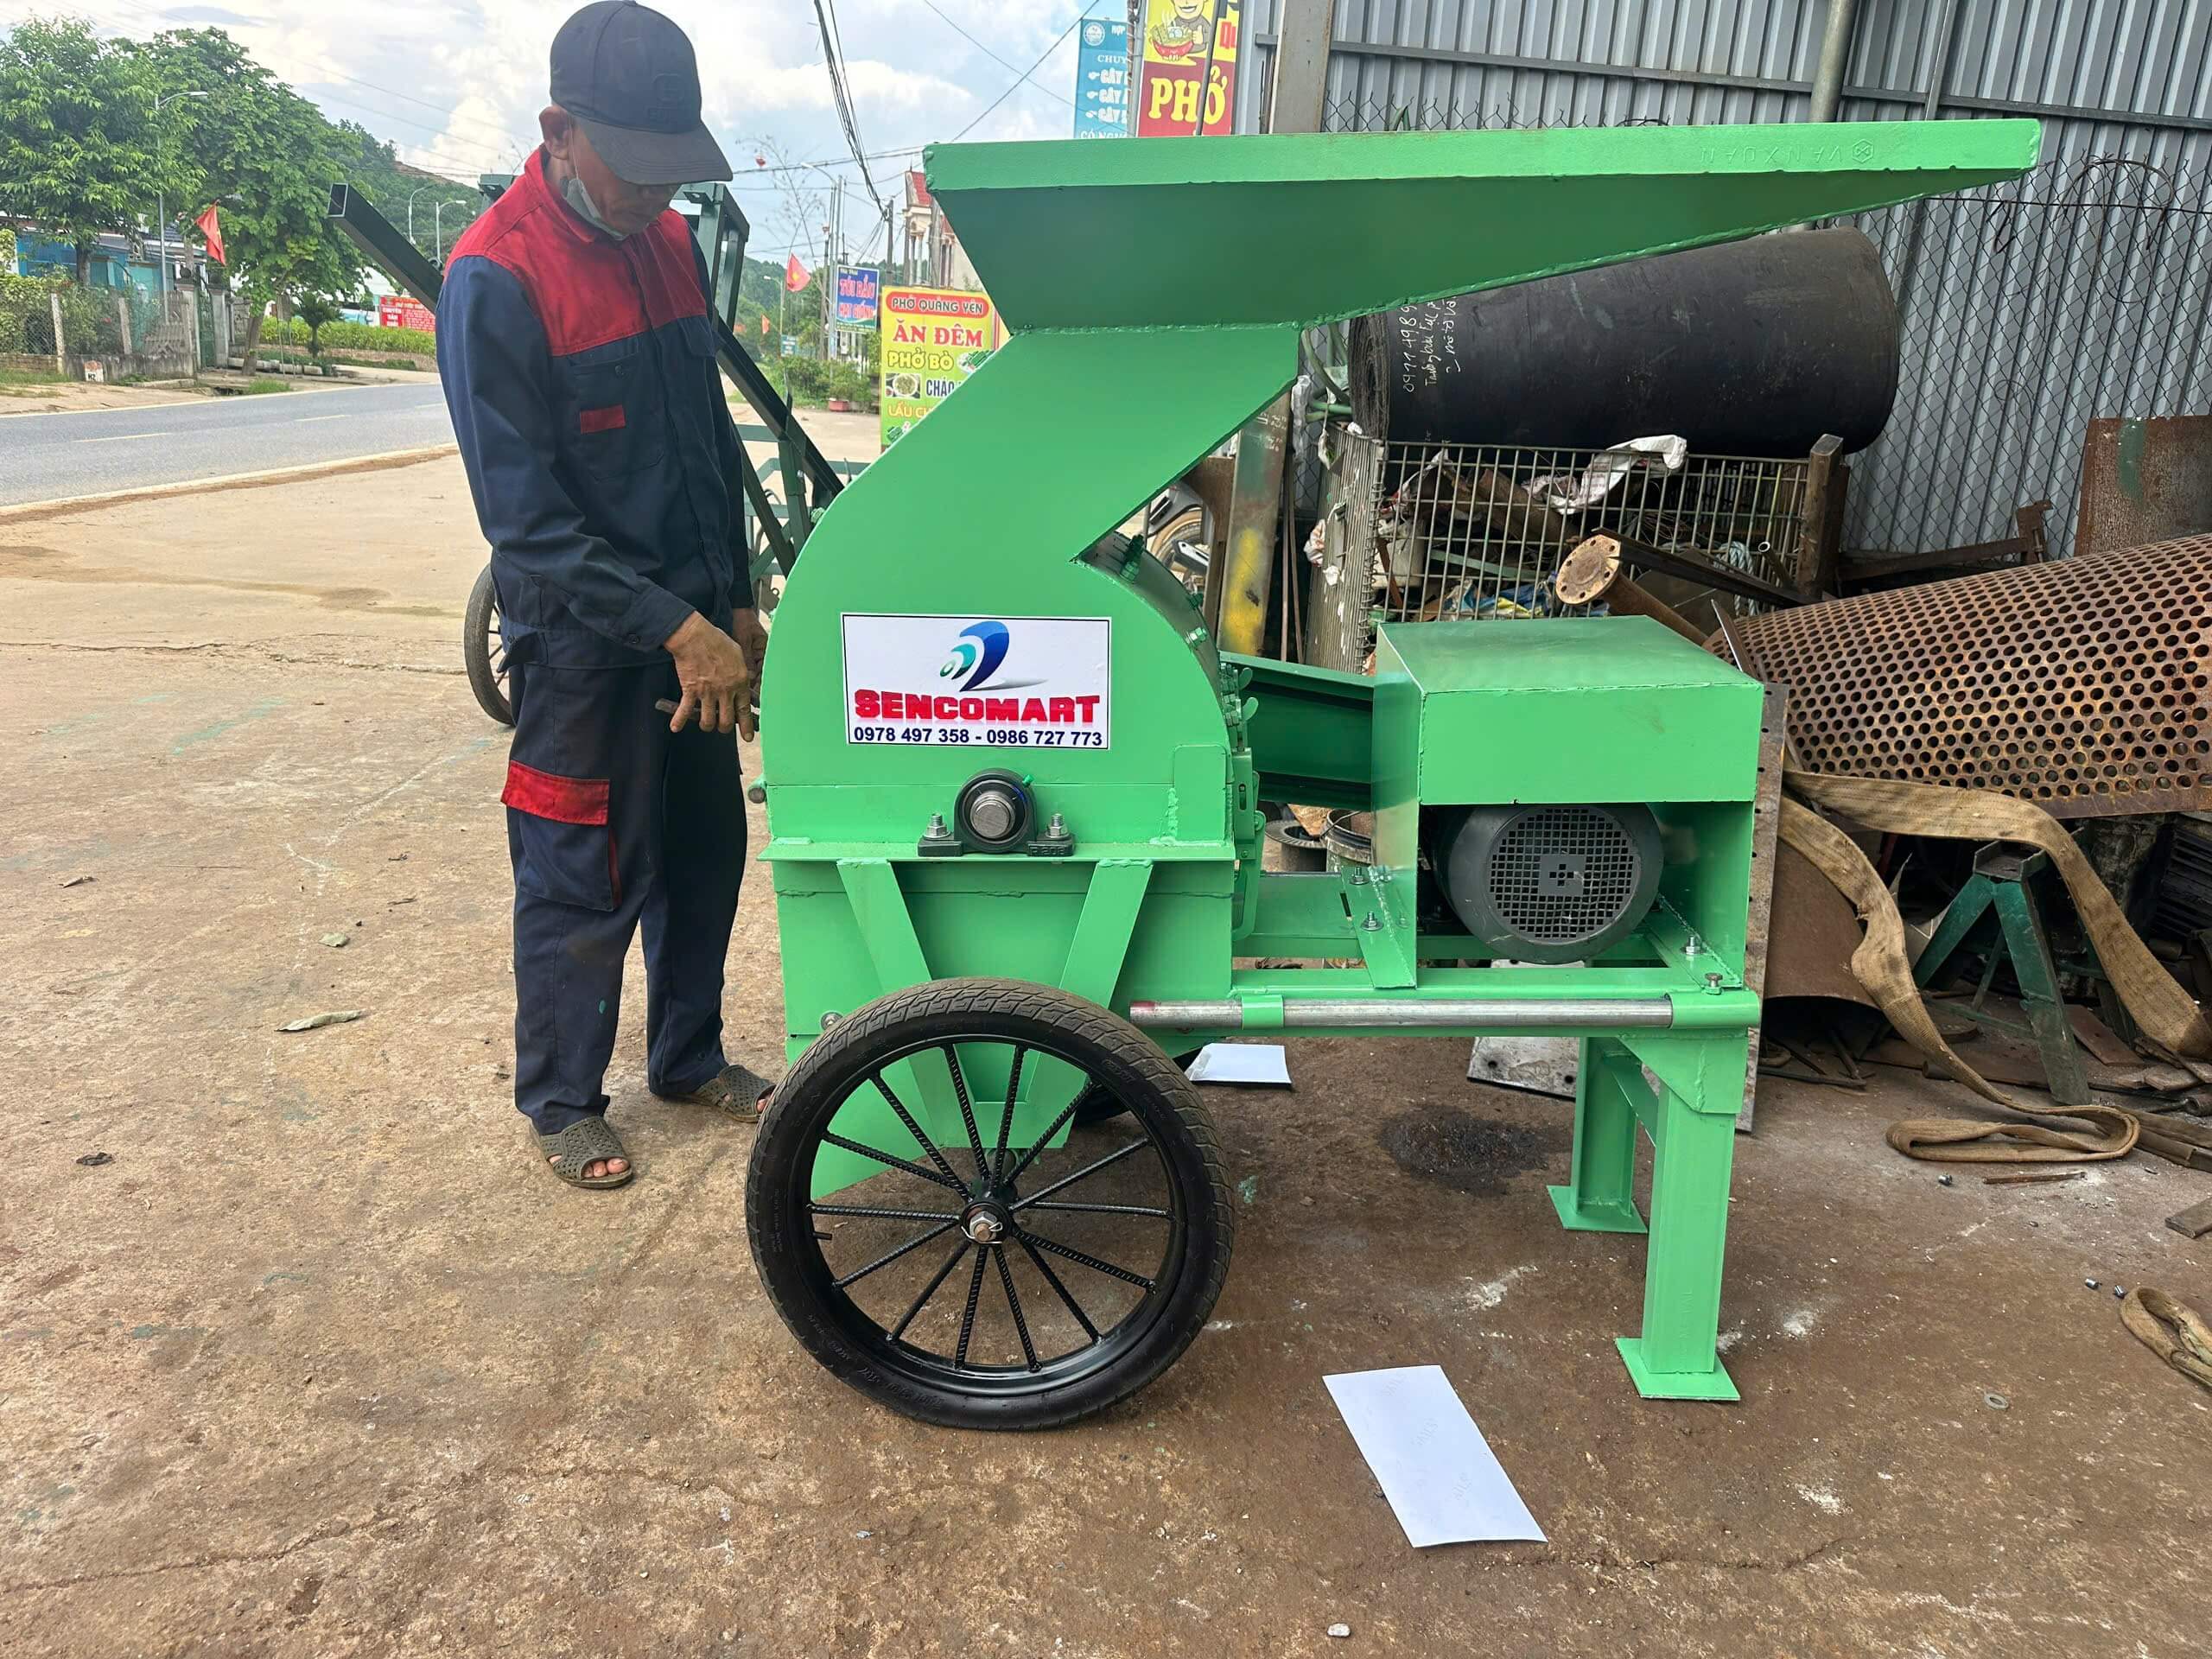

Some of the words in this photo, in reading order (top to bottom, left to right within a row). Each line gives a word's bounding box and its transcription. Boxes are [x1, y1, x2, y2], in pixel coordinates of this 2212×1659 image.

[1148, 65, 1229, 124] PHỞ
[893, 319, 926, 344] ĂN
[934, 323, 983, 347] ĐÊM
[887, 347, 926, 369] PHỞ
[928, 351, 954, 372] BÒ
[855, 689, 1100, 723] SENCOMART
[854, 727, 896, 741] 0978
[900, 728, 932, 742] 497
[938, 728, 969, 743] 358
[987, 729, 1028, 744] 0986
[1034, 730, 1065, 745] 727
[1071, 732, 1103, 746] 773
